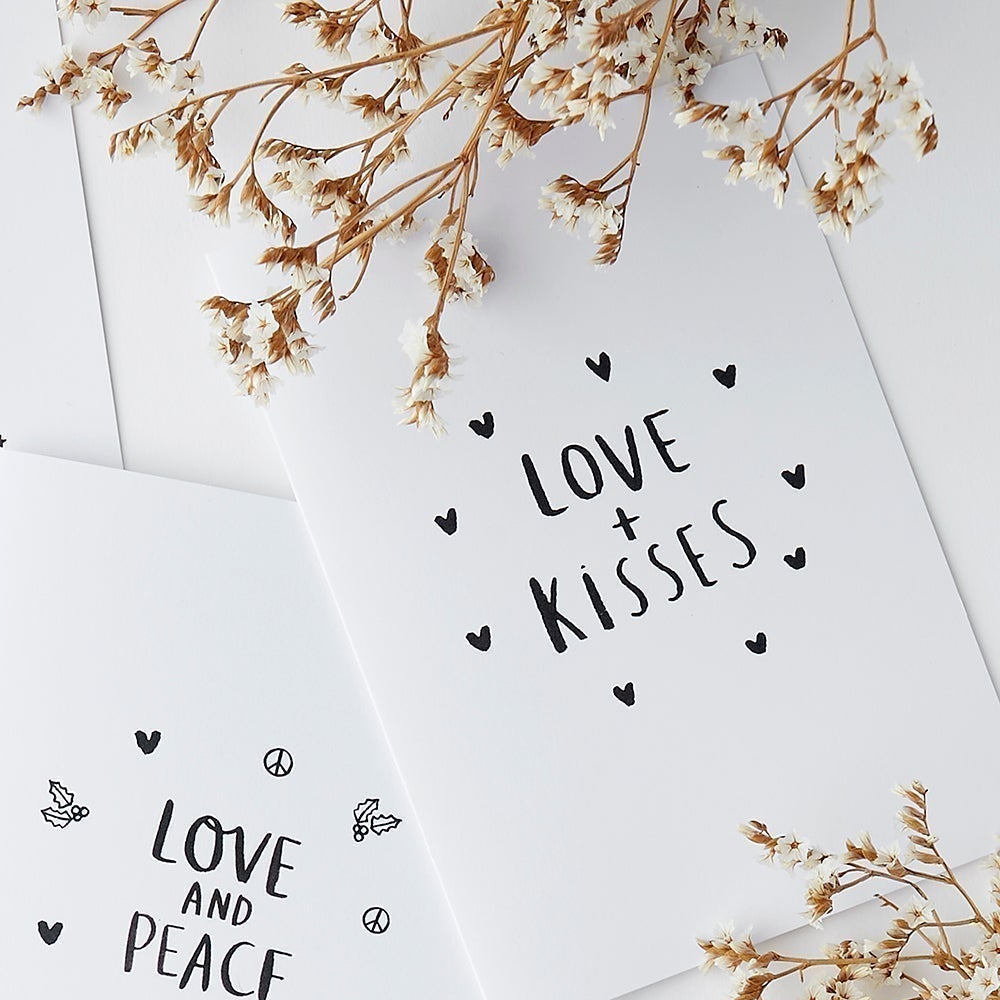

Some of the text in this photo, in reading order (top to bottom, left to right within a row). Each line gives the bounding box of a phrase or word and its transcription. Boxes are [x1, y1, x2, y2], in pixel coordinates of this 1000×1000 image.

[521, 408, 691, 517] LOVE
[611, 506, 640, 541] +
[151, 798, 302, 899] LOVE
[181, 881, 253, 927] AND
